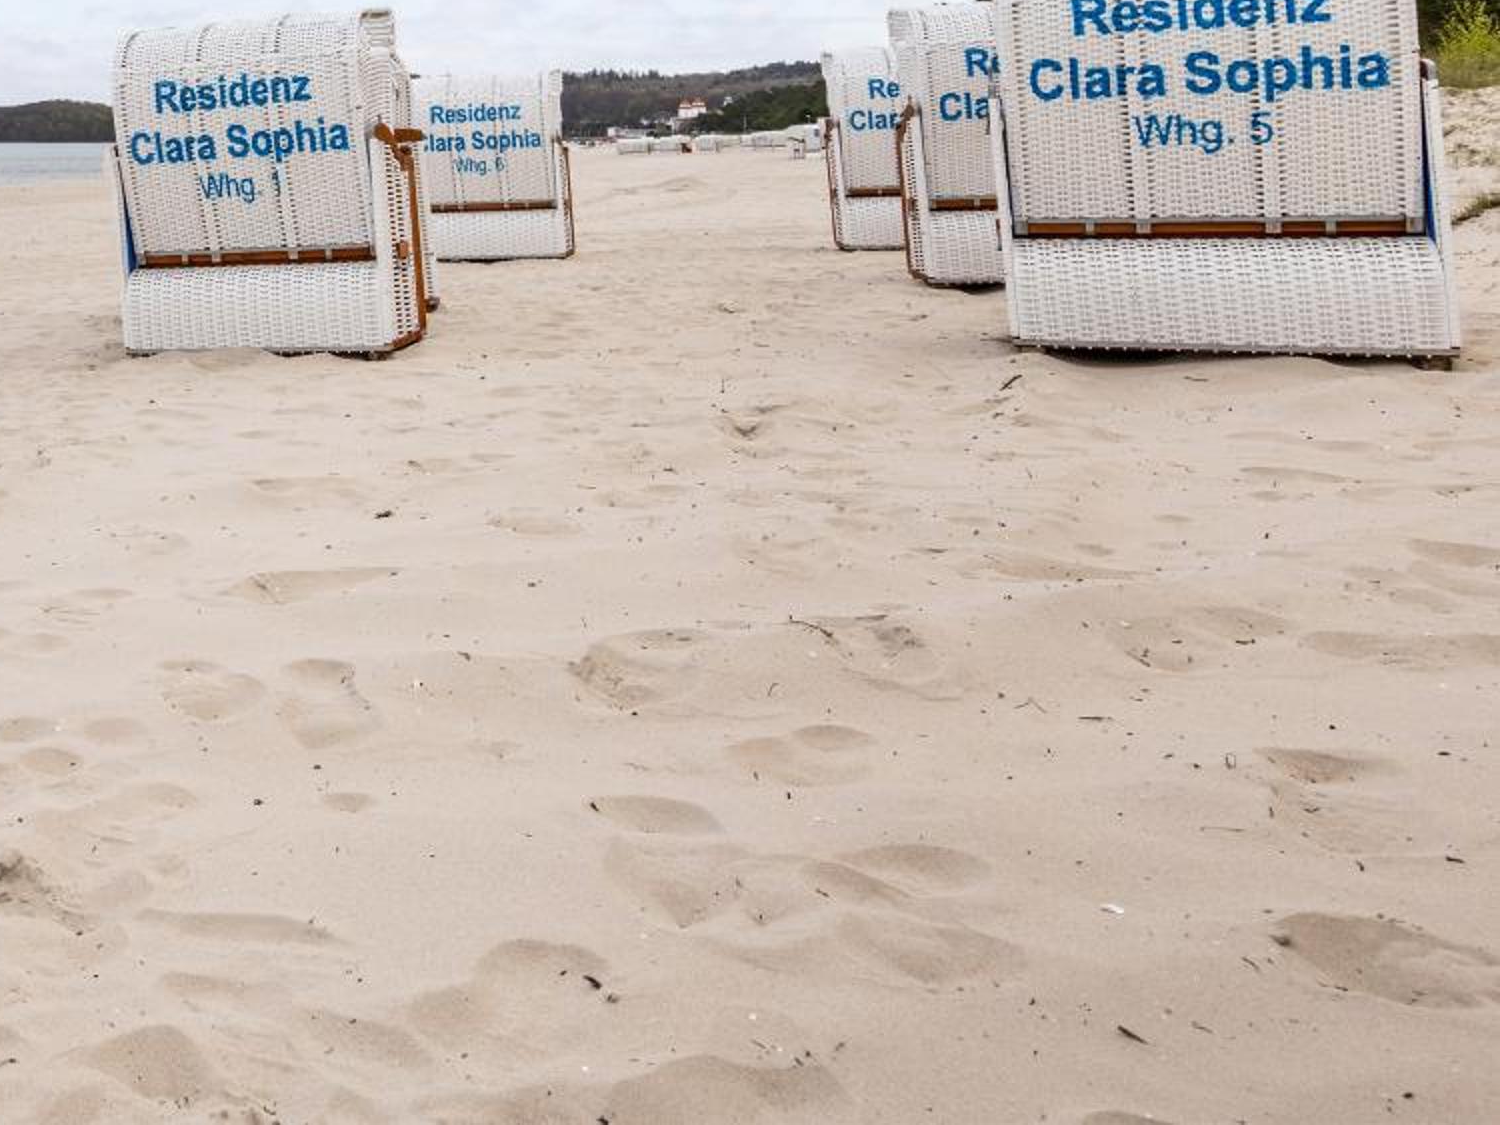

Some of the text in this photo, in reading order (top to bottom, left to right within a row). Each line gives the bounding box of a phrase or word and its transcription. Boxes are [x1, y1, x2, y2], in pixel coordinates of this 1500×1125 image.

[155, 73, 312, 113] Residenz
[1029, 45, 1391, 103] Clara Sophia
[430, 103, 521, 124] Residenz
[1134, 111, 1274, 154] Whg. 5
[131, 117, 349, 165] Clara Sophia
[424, 129, 541, 154] lara Sophia
[454, 156, 492, 176] Whg.
